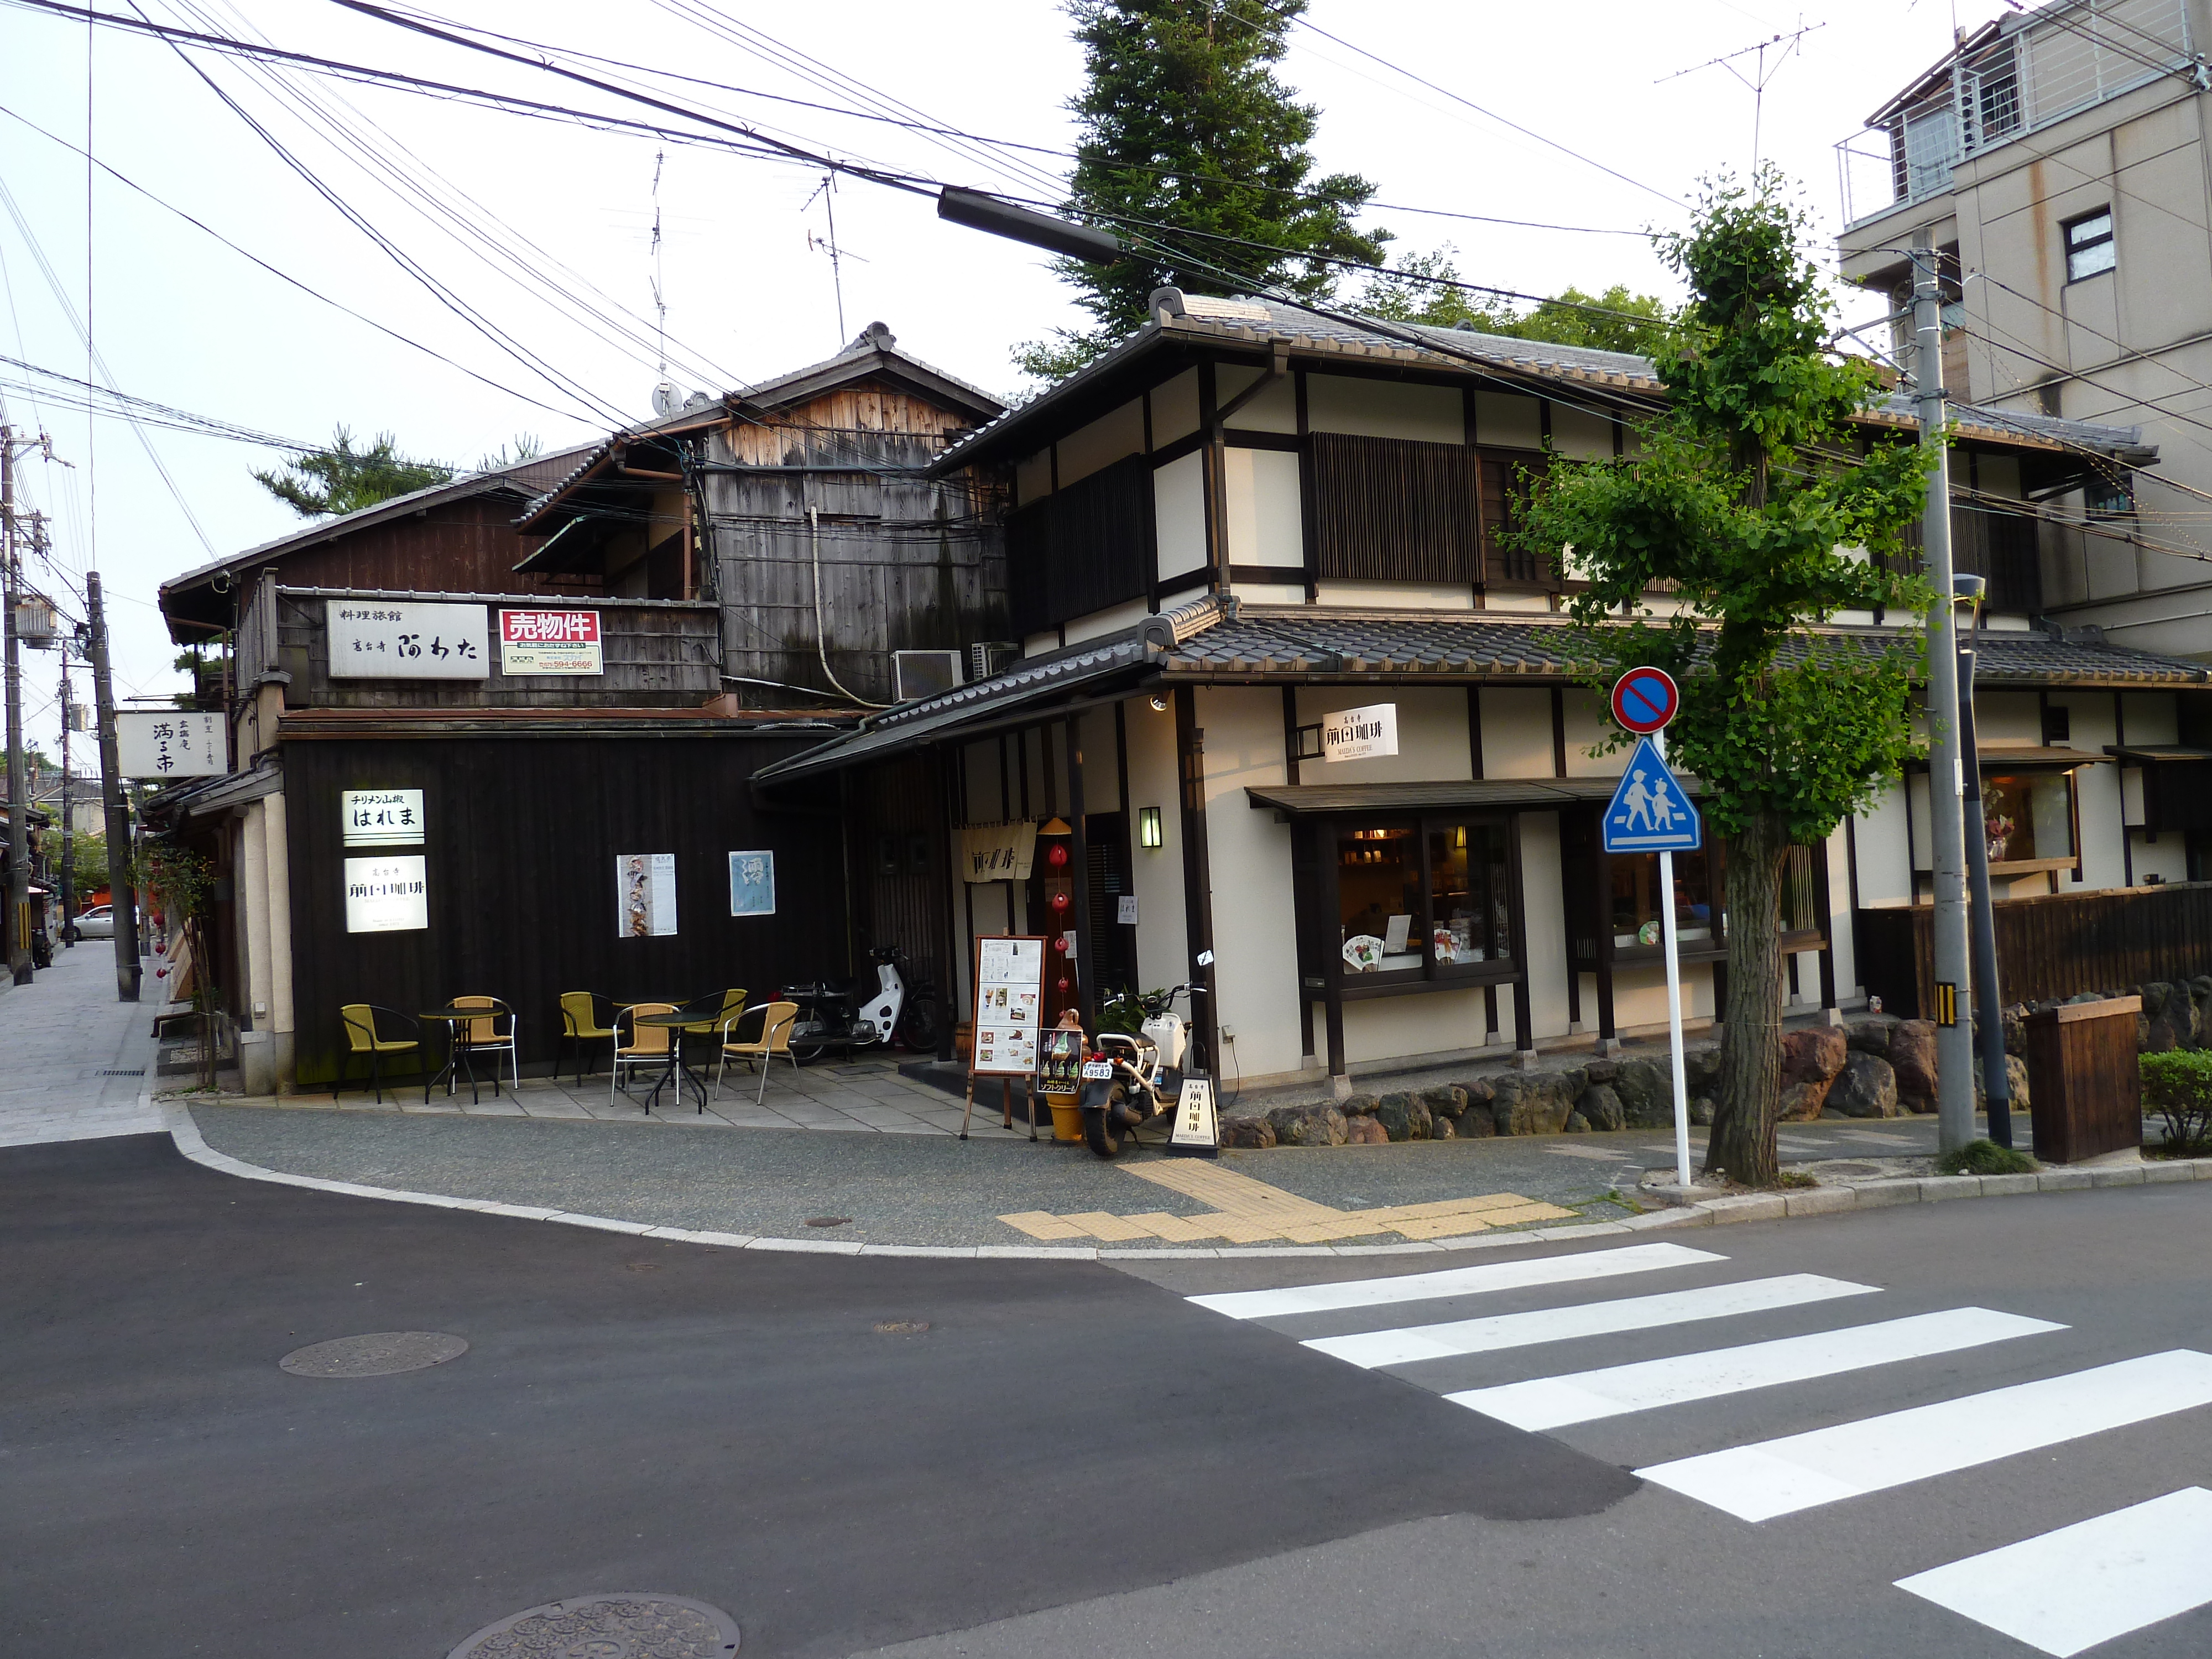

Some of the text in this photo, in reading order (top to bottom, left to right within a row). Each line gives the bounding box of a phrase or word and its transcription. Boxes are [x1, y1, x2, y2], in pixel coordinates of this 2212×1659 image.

[339, 609, 403, 622] 料理旅館
[510, 612, 592, 640] 売物件
[1326, 721, 1383, 746] 前田珈琲
[1337, 747, 1355, 755] MAEDA'S
[1357, 744, 1373, 753] COFFEE
[351, 794, 405, 805] チリメン山椒
[353, 806, 416, 827] はれま
[372, 867, 400, 877] 高台寺
[1089, 1068, 1110, 1077] 9583
[1041, 1084, 1076, 1092] ソフトクリーム
